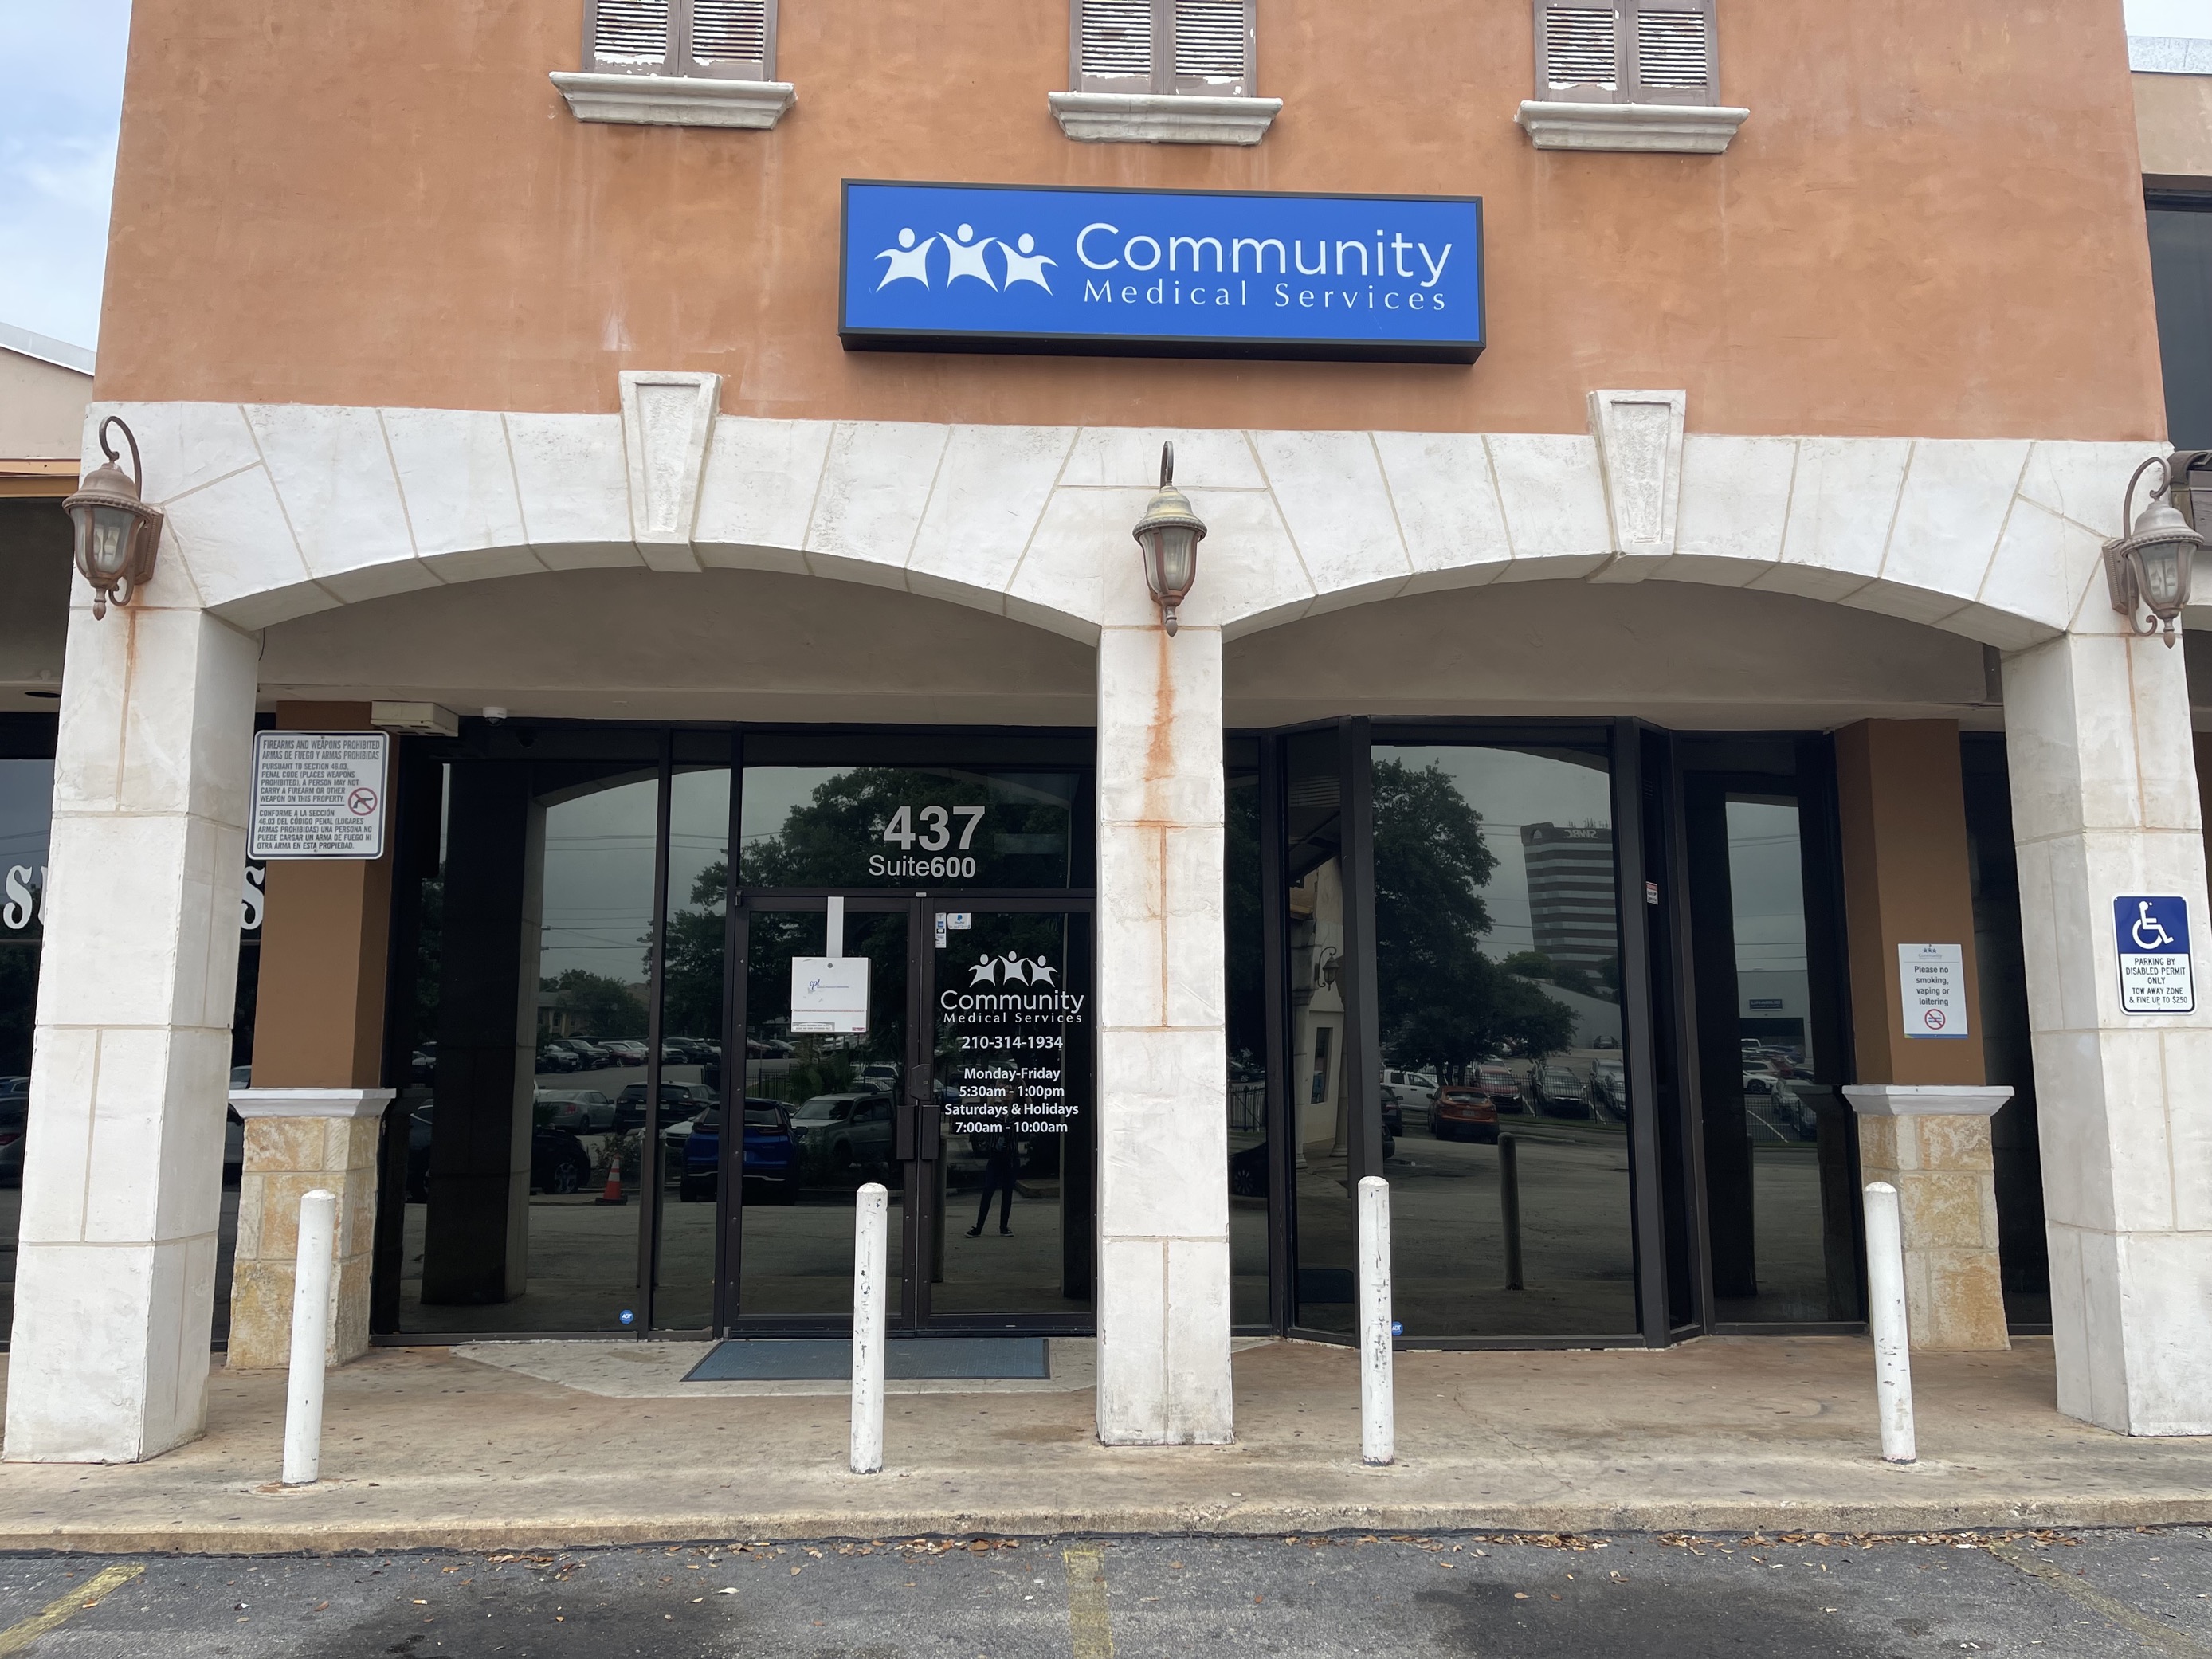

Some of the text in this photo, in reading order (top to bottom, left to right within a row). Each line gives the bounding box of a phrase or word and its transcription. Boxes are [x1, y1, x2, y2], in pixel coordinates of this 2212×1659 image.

[1076, 222, 1453, 288] Community
[1084, 278, 1445, 312] Medical Services
[263, 740, 380, 749] FIREARMS AND WEAPONS PROHIBITED
[262, 751, 379, 759] ARMAS DE FUEGO Y ARMAS PROHIBIDAS
[884, 806, 985, 850] 437
[940, 990, 1084, 1014] Community
[1919, 998, 1949, 1006] loitering
[943, 1013, 1081, 1023] Medical Services
[961, 1037, 1063, 1049] 210-314-1934
[964, 1068, 1060, 1082] Monday-Friday
[959, 1086, 1006, 1096] 5:30am
[1018, 1086, 1065, 1100] 1:00pm
[945, 1104, 1079, 1117] Saturdays & Holidays
[955, 1122, 1002, 1133] 7:00am
[1014, 1122, 1068, 1133] 10:00am
